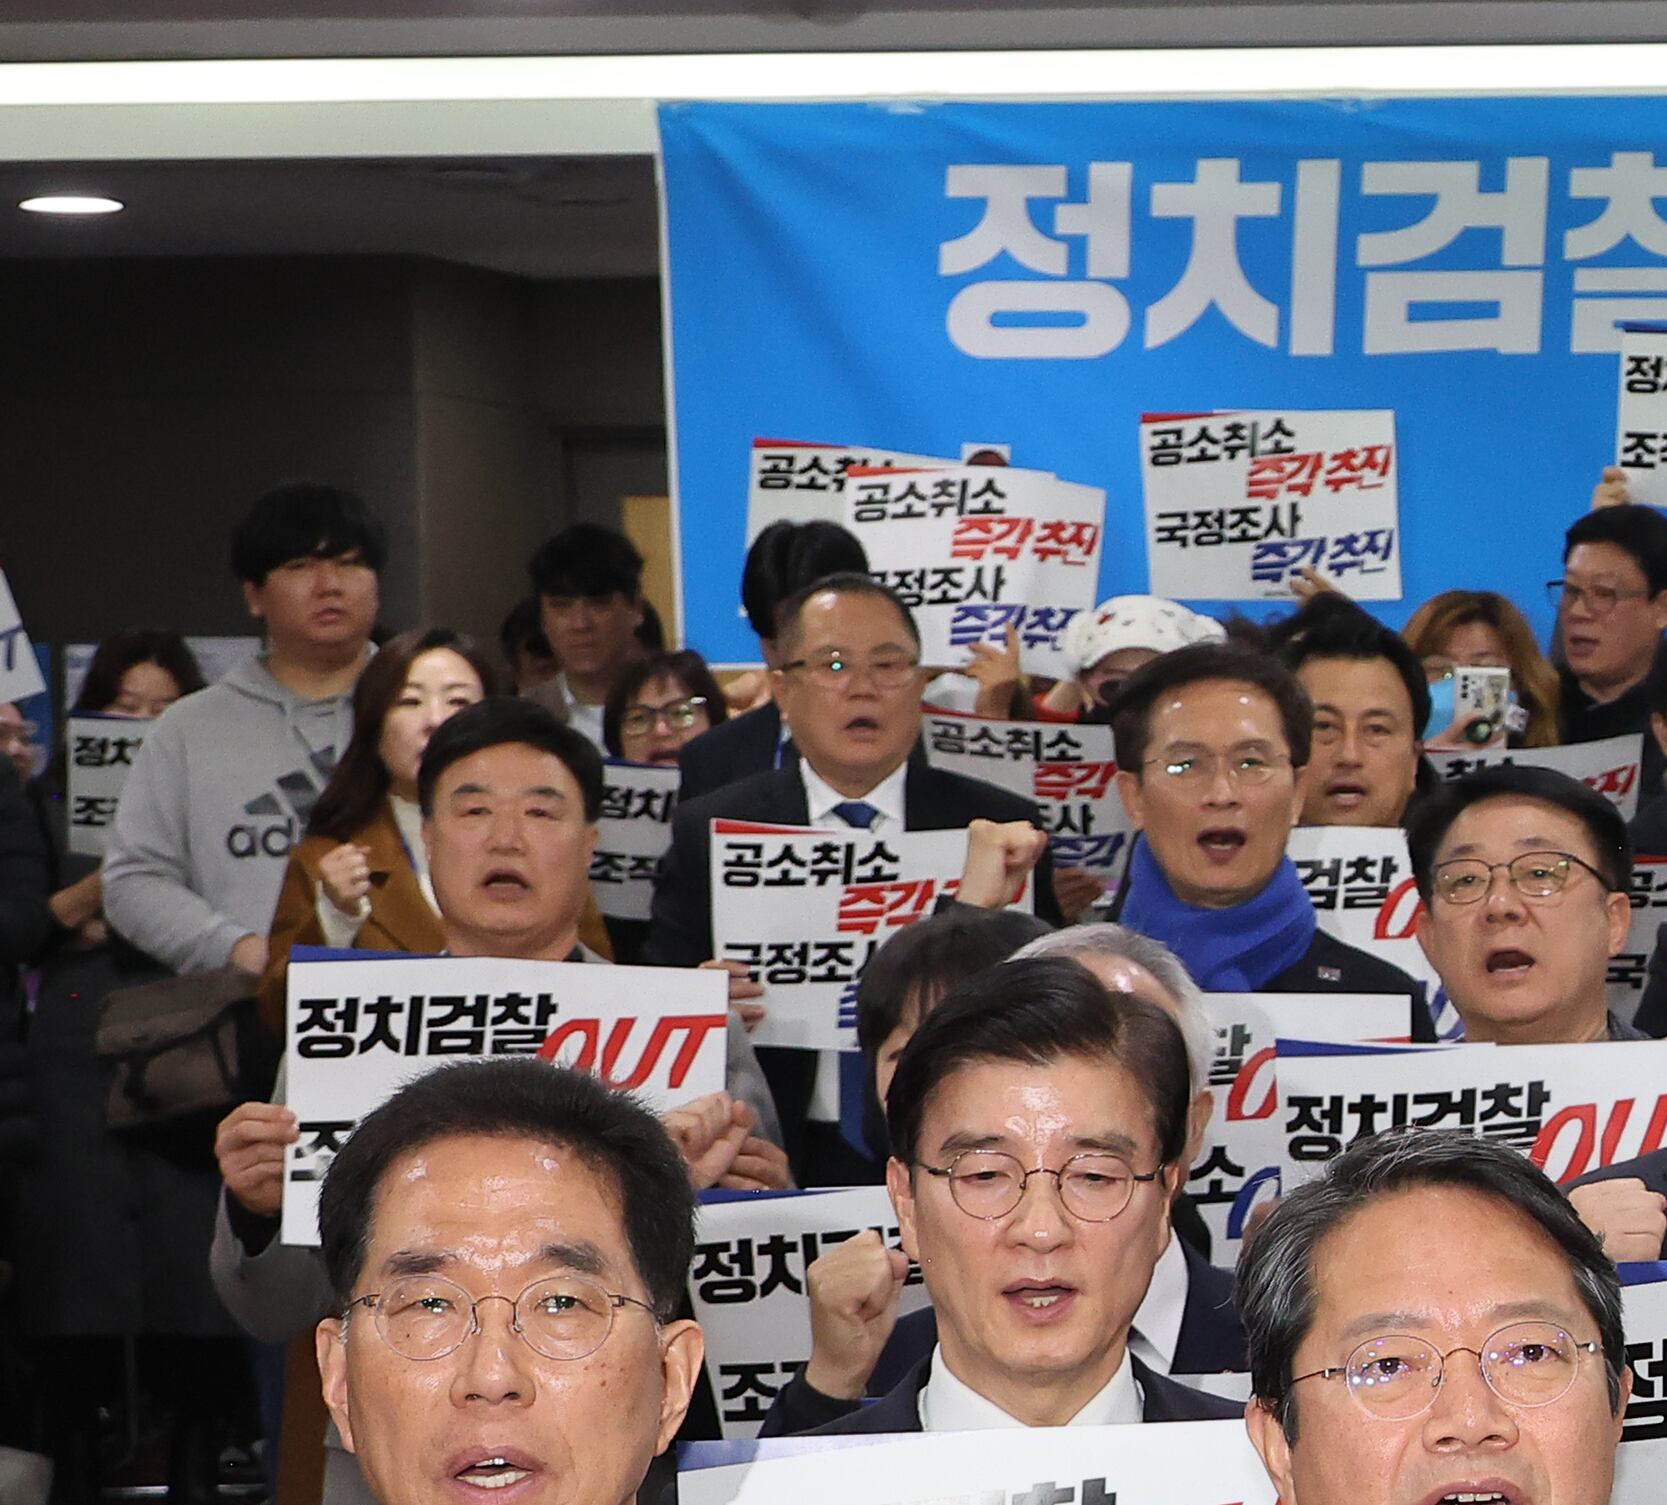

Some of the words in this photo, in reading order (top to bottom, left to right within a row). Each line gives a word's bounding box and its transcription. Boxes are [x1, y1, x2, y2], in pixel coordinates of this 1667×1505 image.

[1150, 417, 1295, 468] 공소취소
[1246, 452, 1326, 501] 즉각
[1324, 443, 1394, 493] 추진
[853, 477, 1007, 523] 공소취소
[1154, 500, 1303, 549] 국정조사
[949, 516, 1035, 562] 즉각
[1030, 520, 1099, 567] 추진
[1251, 536, 1328, 583] 즉각
[1326, 527, 1396, 577] 추진
[931, 719, 1084, 763] 공소취소
[1033, 761, 1117, 800] 즉각
[721, 842, 901, 888] 공소취소
[295, 993, 558, 1059] 정치검찰
[536, 1014, 728, 1090] OUT
[1285, 1080, 1551, 1162] 정치검찰
